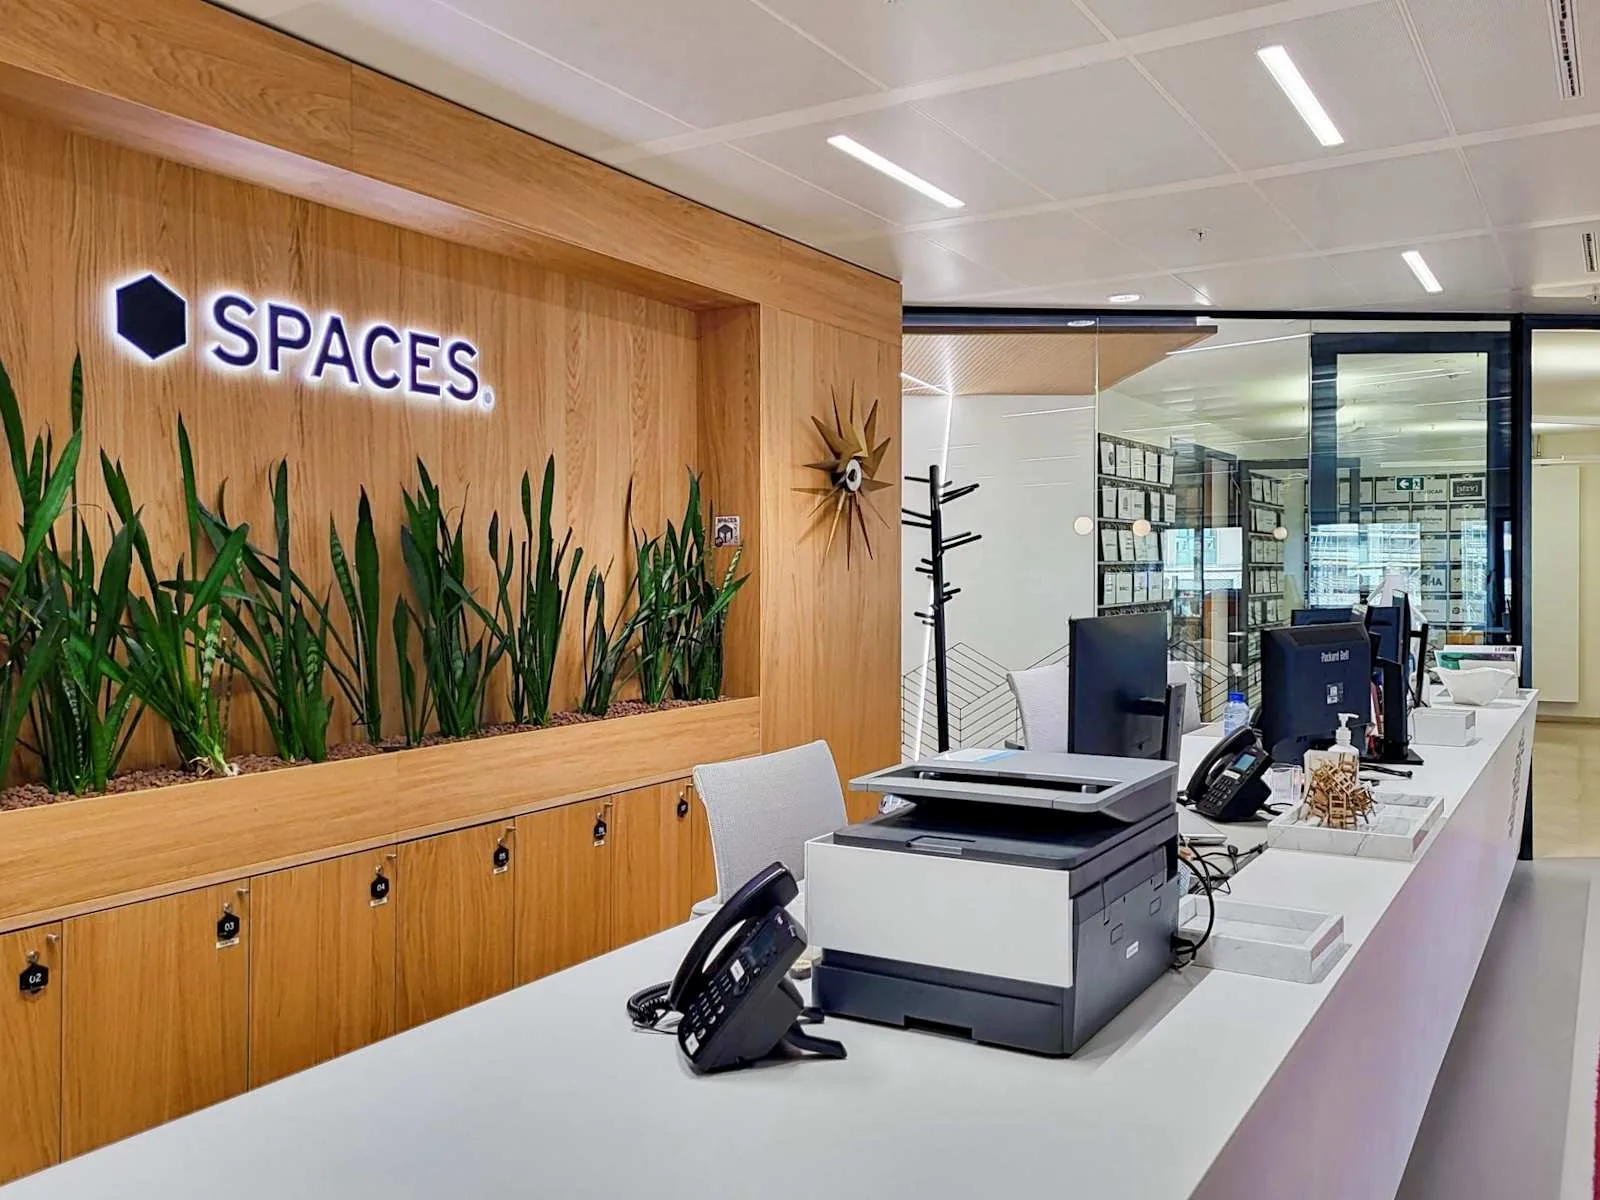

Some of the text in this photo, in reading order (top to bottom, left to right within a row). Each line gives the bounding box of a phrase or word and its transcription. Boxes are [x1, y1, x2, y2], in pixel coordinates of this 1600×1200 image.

[211, 294, 479, 402] SPACES
[1320, 649, 1350, 663] Packard Bell
[376, 882, 385, 891] 04
[224, 921, 235, 931] 03
[29, 972, 42, 984] 02
